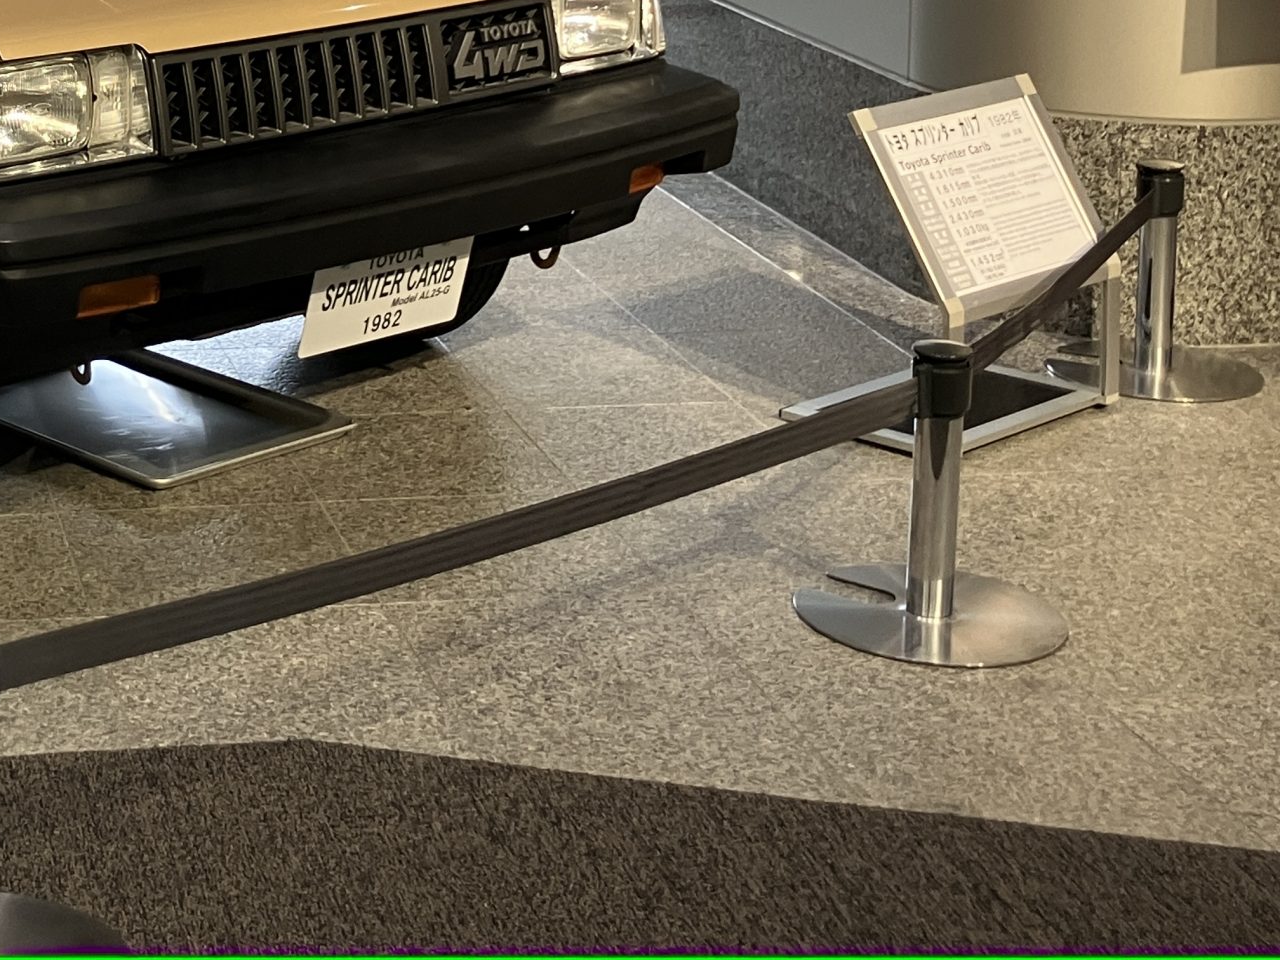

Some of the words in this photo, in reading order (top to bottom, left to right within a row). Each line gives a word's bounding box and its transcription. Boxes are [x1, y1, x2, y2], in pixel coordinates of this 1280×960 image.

[480, 19, 538, 43] TOYOTA
[453, 30, 545, 80] 4WD
[898, 156, 930, 172] Toyota
[930, 147, 967, 165] Sprinter
[967, 141, 991, 155] Carib
[370, 248, 424, 270] TOYOTA
[322, 268, 405, 312] SPRINTER
[407, 256, 457, 291] CARIB
[390, 294, 417, 308] Model
[419, 285, 451, 301] AL25-G
[363, 309, 403, 335] 1982
